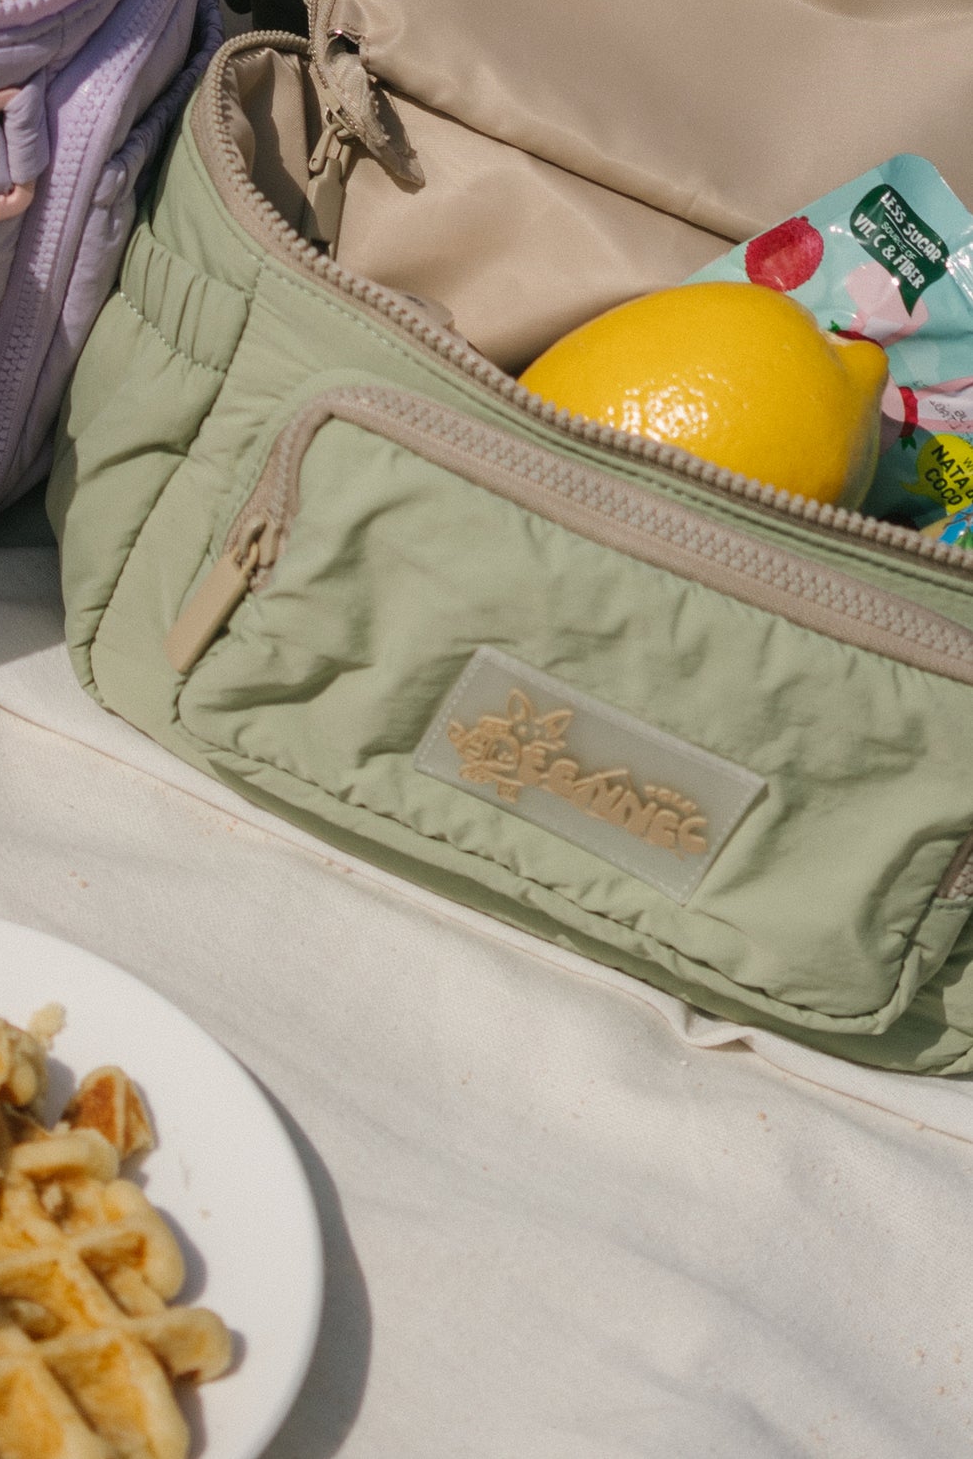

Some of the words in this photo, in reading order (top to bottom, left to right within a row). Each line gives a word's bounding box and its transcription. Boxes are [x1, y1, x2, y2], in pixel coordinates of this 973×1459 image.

[880, 190, 907, 224] LESS
[902, 223, 942, 264] SUGAR
[881, 221, 907, 253] SOURCE
[904, 249, 918, 261] OF
[873, 233, 887, 248] C
[881, 244, 896, 261] &
[892, 253, 925, 290] FIBER
[924, 467, 963, 506] COCO
[931, 444, 970, 490] NATA
